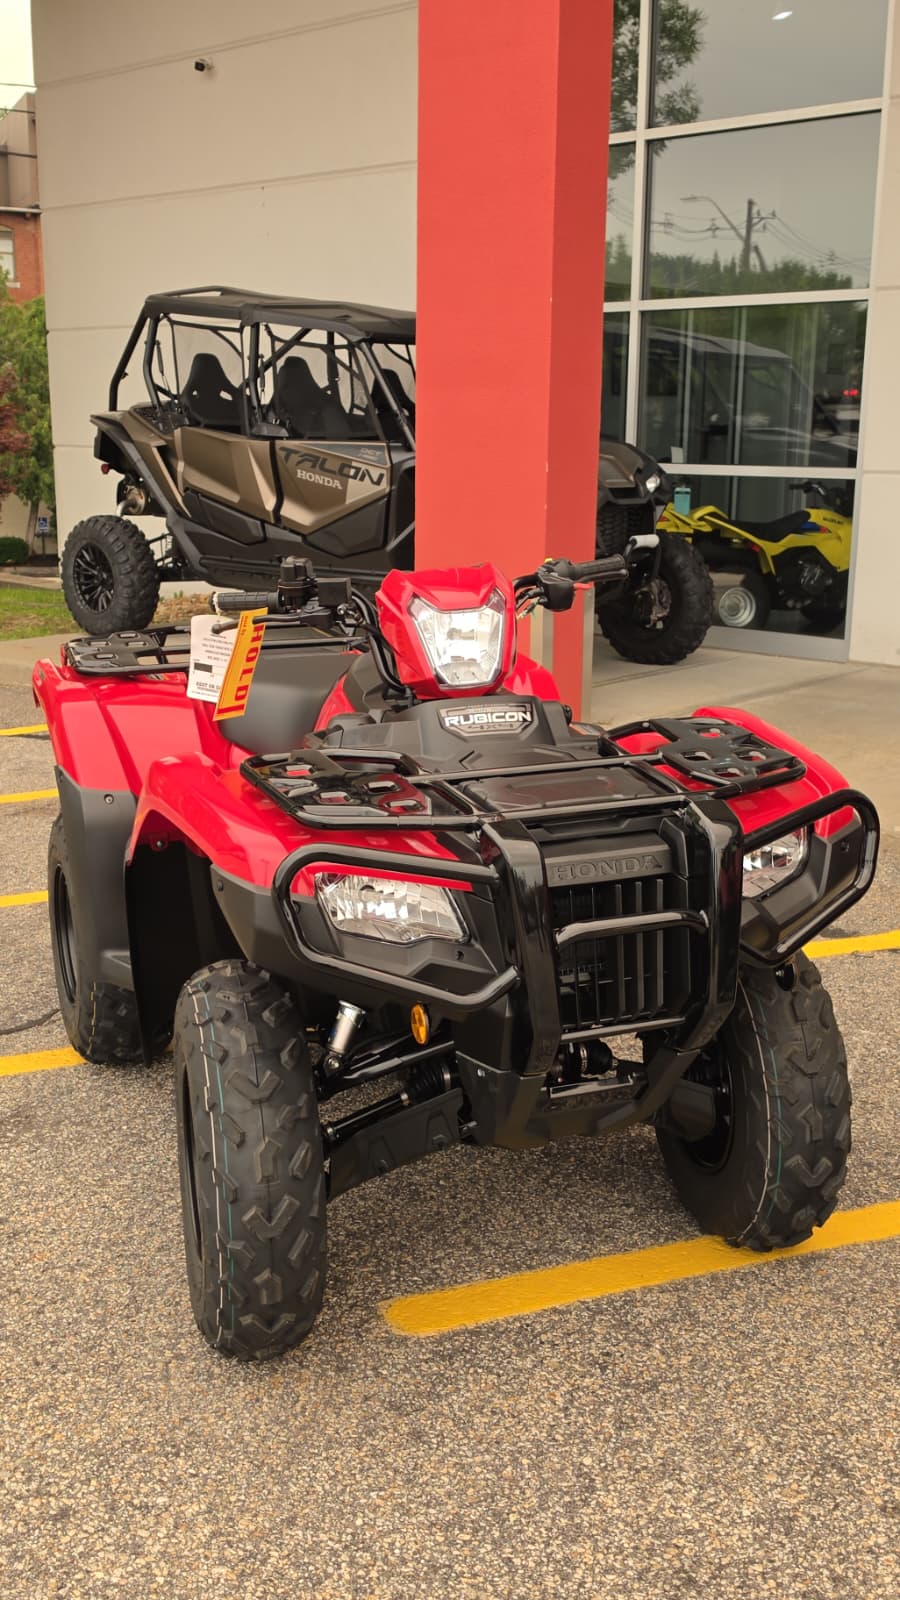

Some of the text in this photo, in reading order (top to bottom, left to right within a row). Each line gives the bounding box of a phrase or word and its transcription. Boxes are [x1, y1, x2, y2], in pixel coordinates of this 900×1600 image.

[279, 446, 385, 487] TALON
[296, 468, 343, 490] HONDA
[444, 711, 532, 727] RUBICON
[551, 854, 663, 881] HONDA
